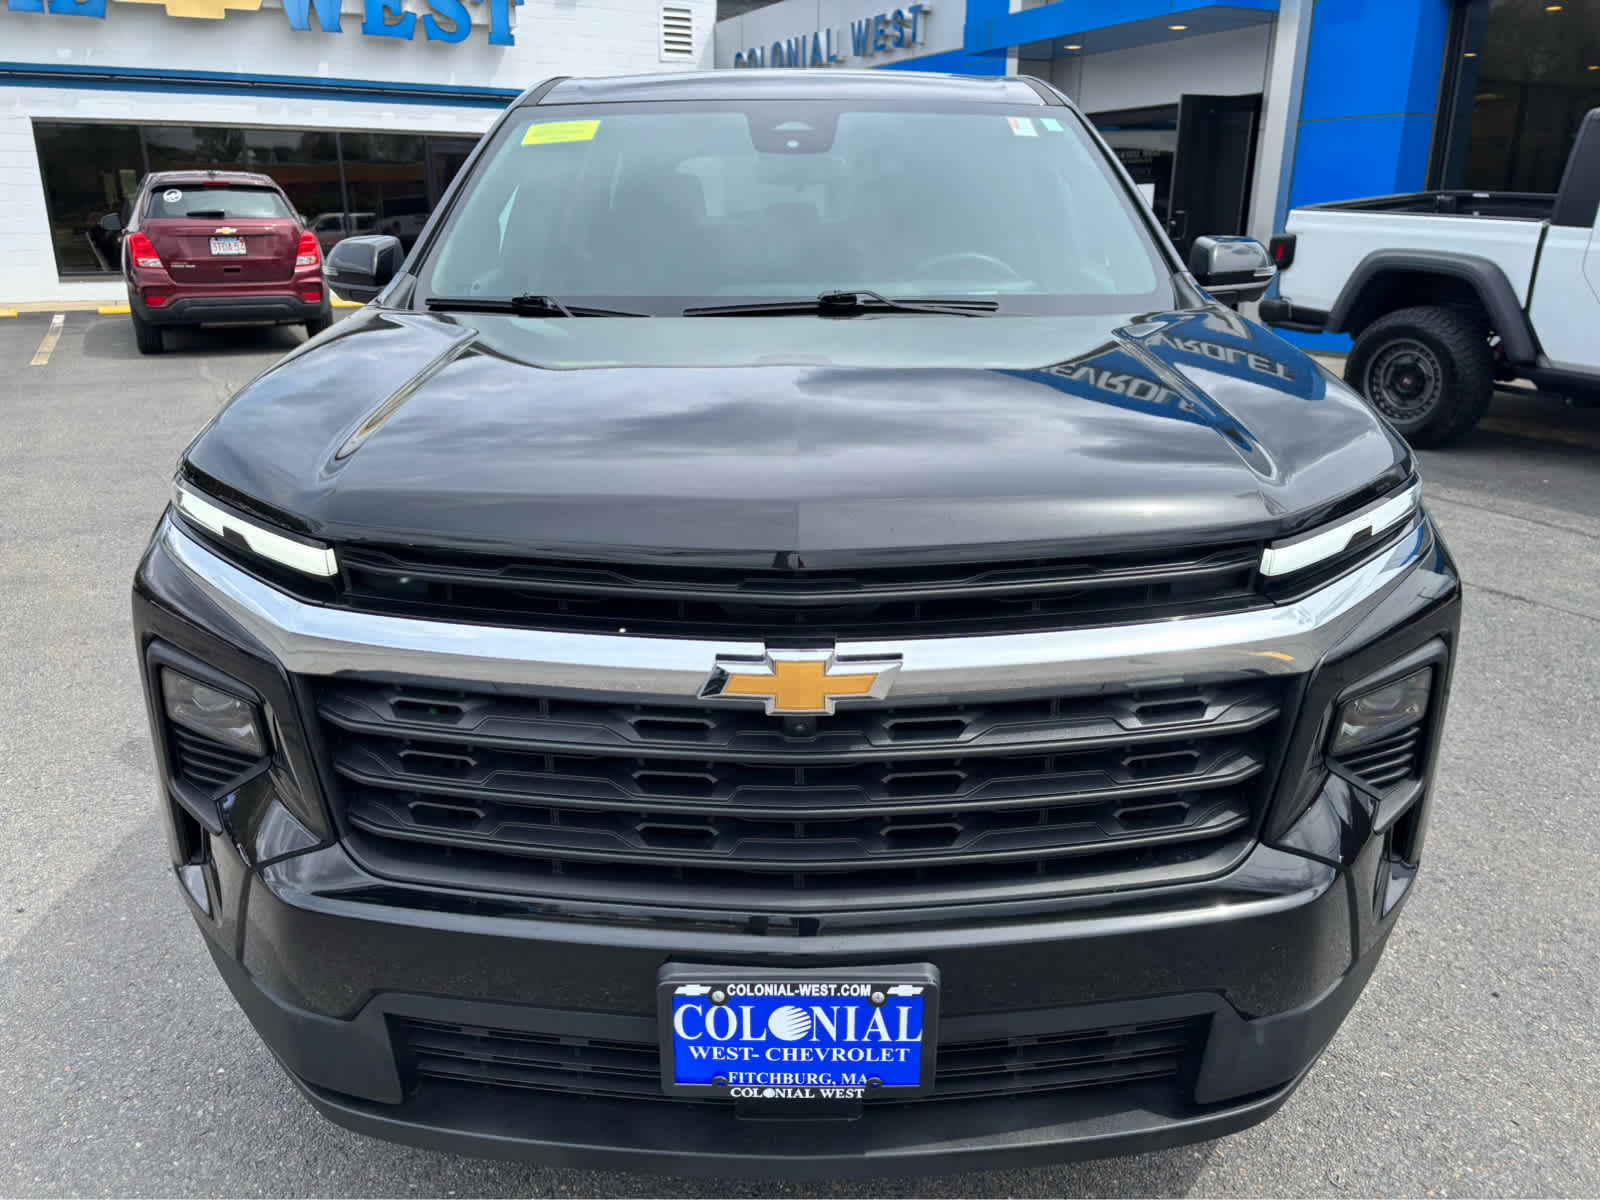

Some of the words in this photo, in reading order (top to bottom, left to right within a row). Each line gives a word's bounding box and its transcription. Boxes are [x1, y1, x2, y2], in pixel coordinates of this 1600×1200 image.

[851, 4, 923, 57] WEST
[727, 984, 871, 997] COLONIAL-WEST.COM
[673, 1003, 923, 1042] COLONIAL
[765, 1047, 910, 1063] CHEVROLET
[728, 1072, 837, 1086] FITCHBURG,
[841, 1073, 868, 1085] MA
[730, 1087, 815, 1099] COLONIAL
[820, 1088, 865, 1099] WEST
